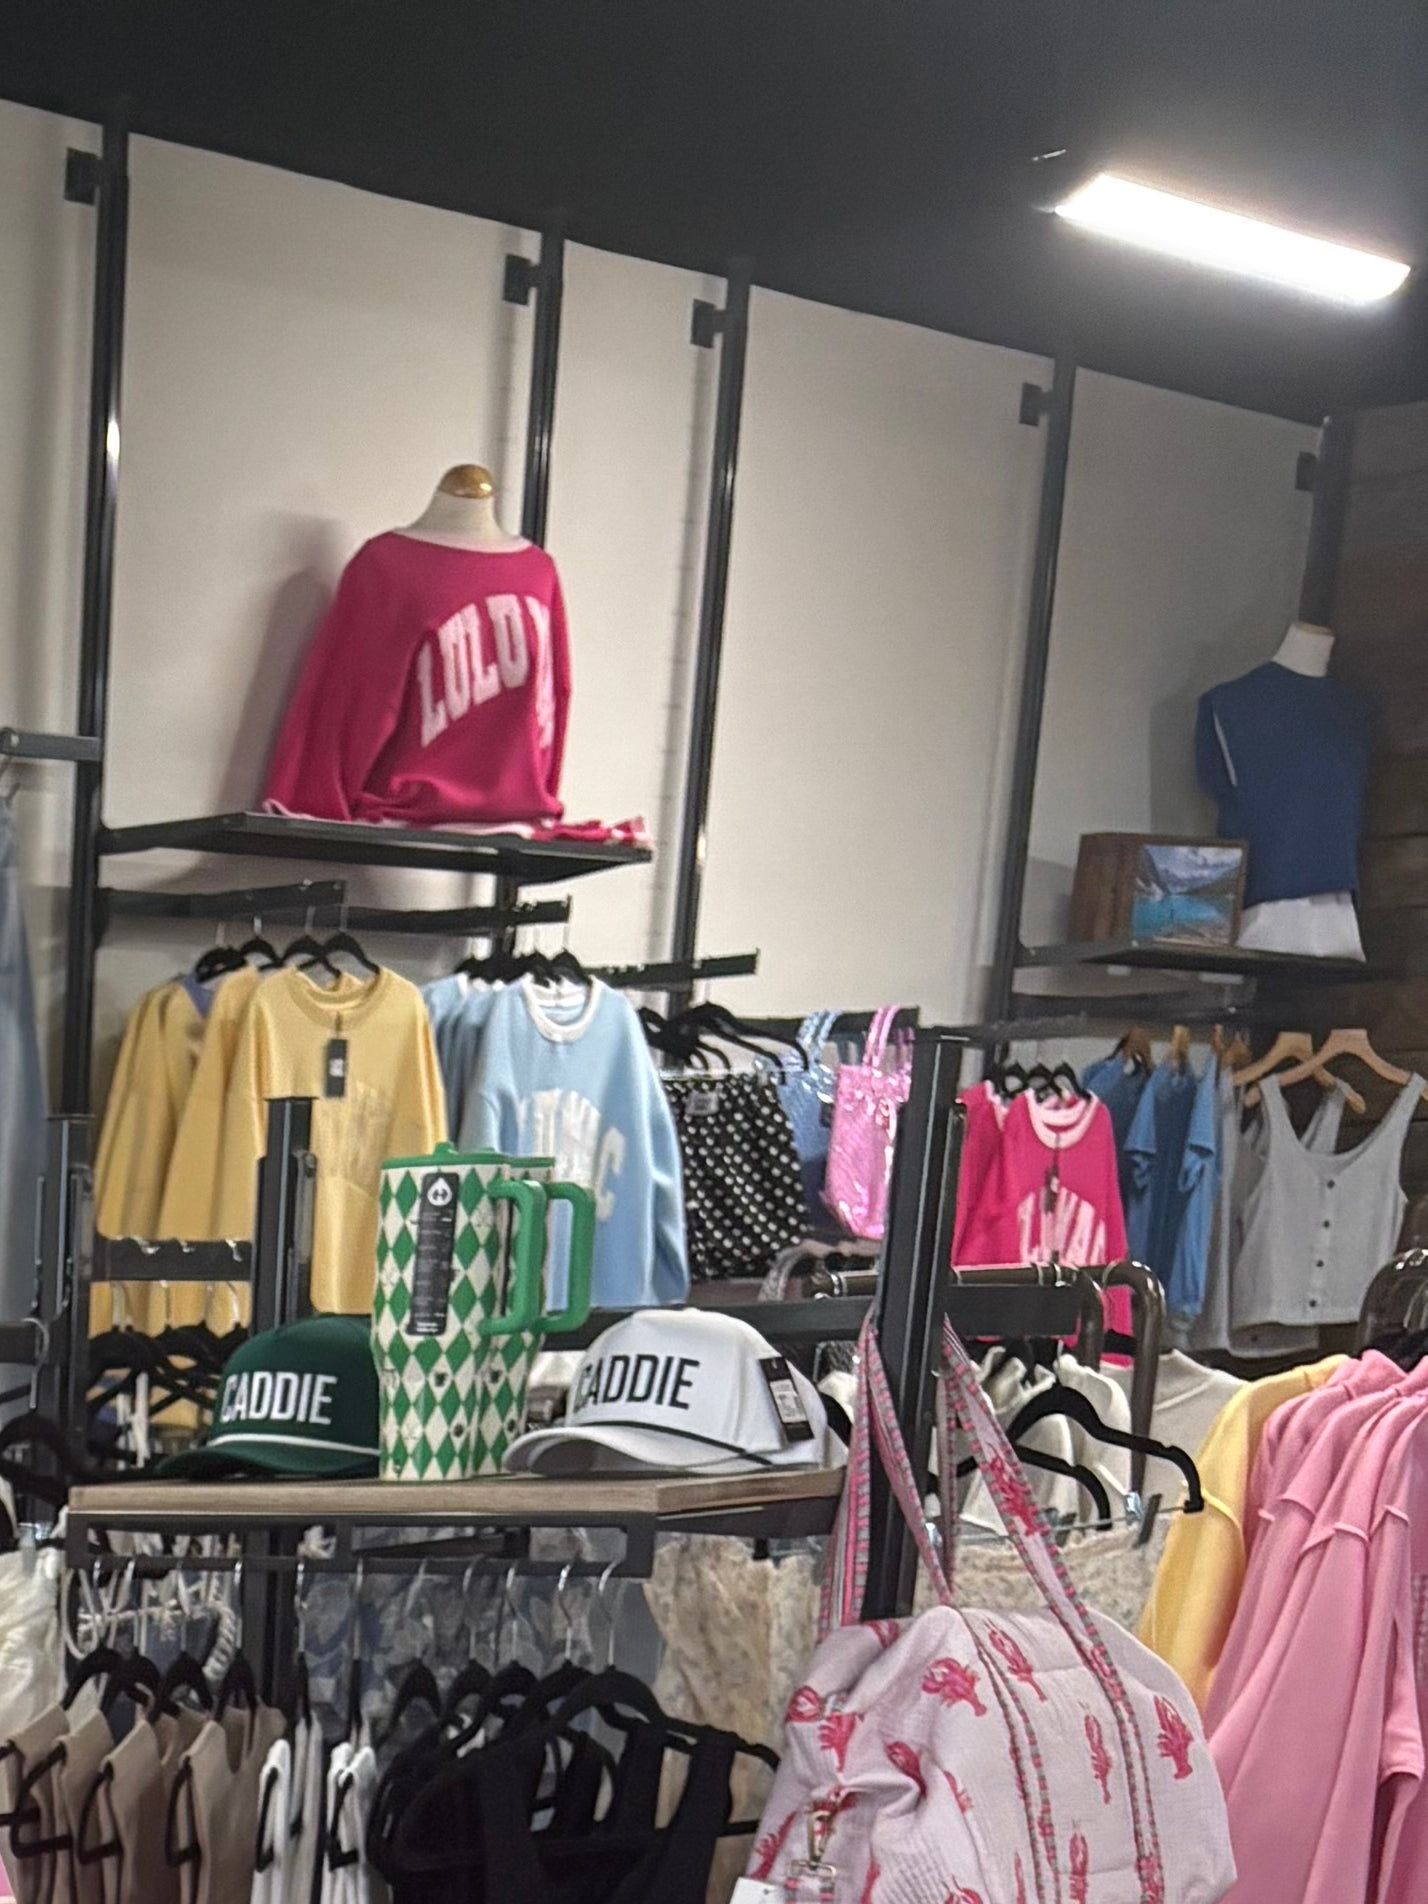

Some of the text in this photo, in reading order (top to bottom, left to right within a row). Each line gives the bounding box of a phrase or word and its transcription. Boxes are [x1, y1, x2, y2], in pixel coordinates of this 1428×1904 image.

[417, 592, 530, 749] LULU
[220, 1371, 338, 1425] CADDIE
[573, 1354, 700, 1414] CADDIE
